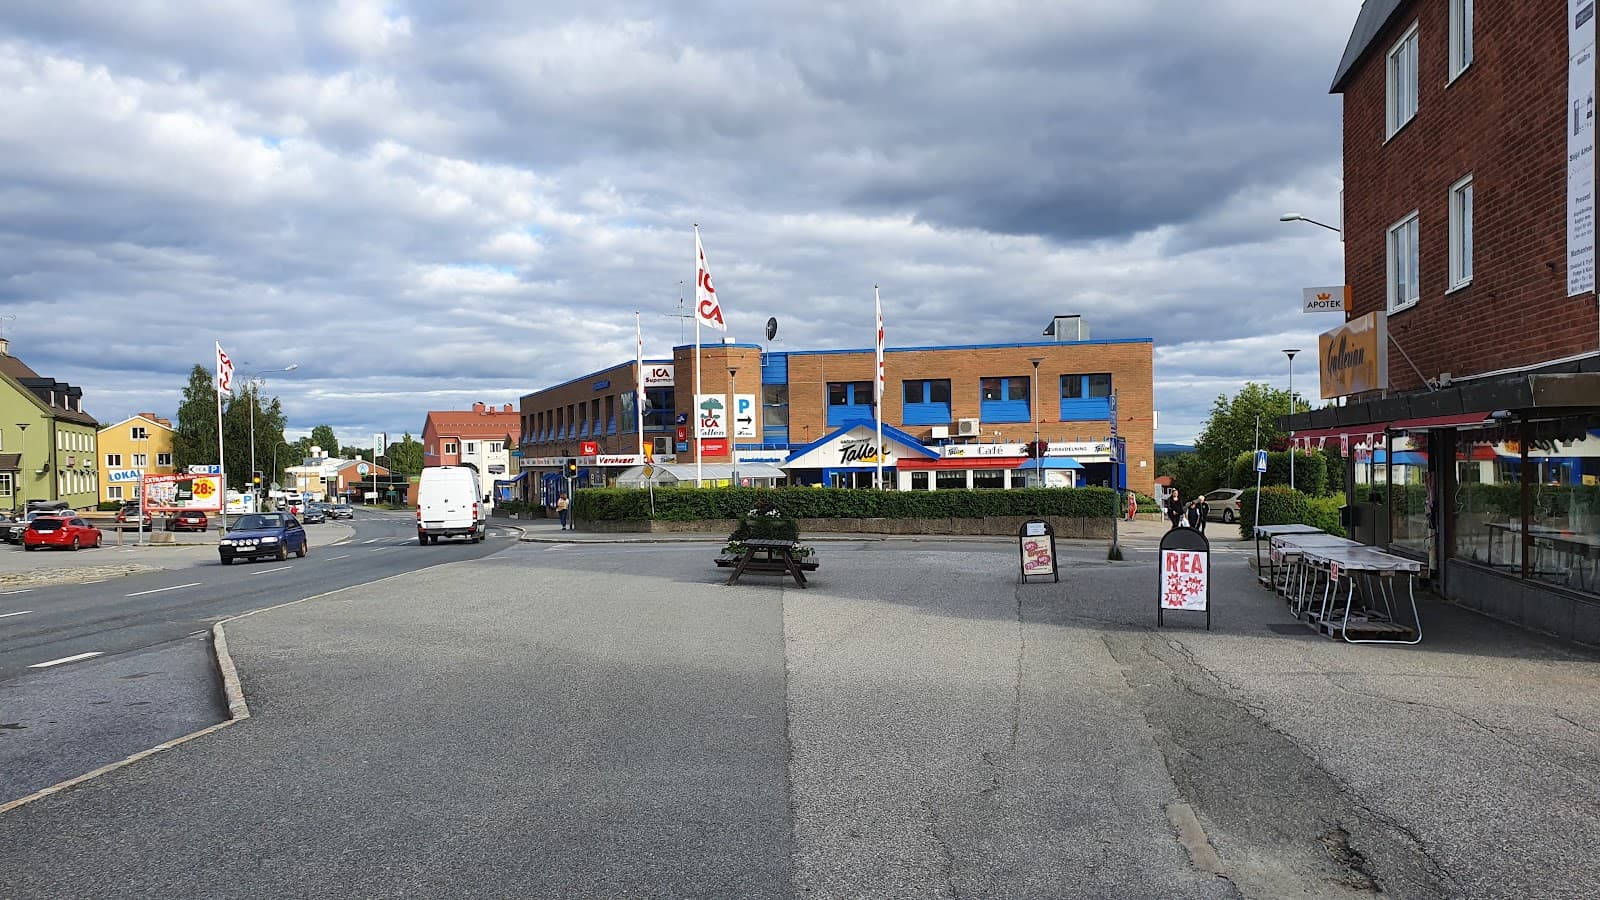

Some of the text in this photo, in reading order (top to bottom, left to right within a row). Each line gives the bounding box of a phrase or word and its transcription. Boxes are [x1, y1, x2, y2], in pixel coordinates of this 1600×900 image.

[1307, 300, 1341, 309] APOTEK
[652, 368, 670, 378] ICA
[738, 399, 750, 414] P
[701, 418, 719, 428] ICA
[838, 442, 891, 464] Tallen
[977, 445, 1004, 455] Café
[193, 483, 215, 494] 28:-
[243, 496, 252, 504] P
[1166, 552, 1203, 574] REA
